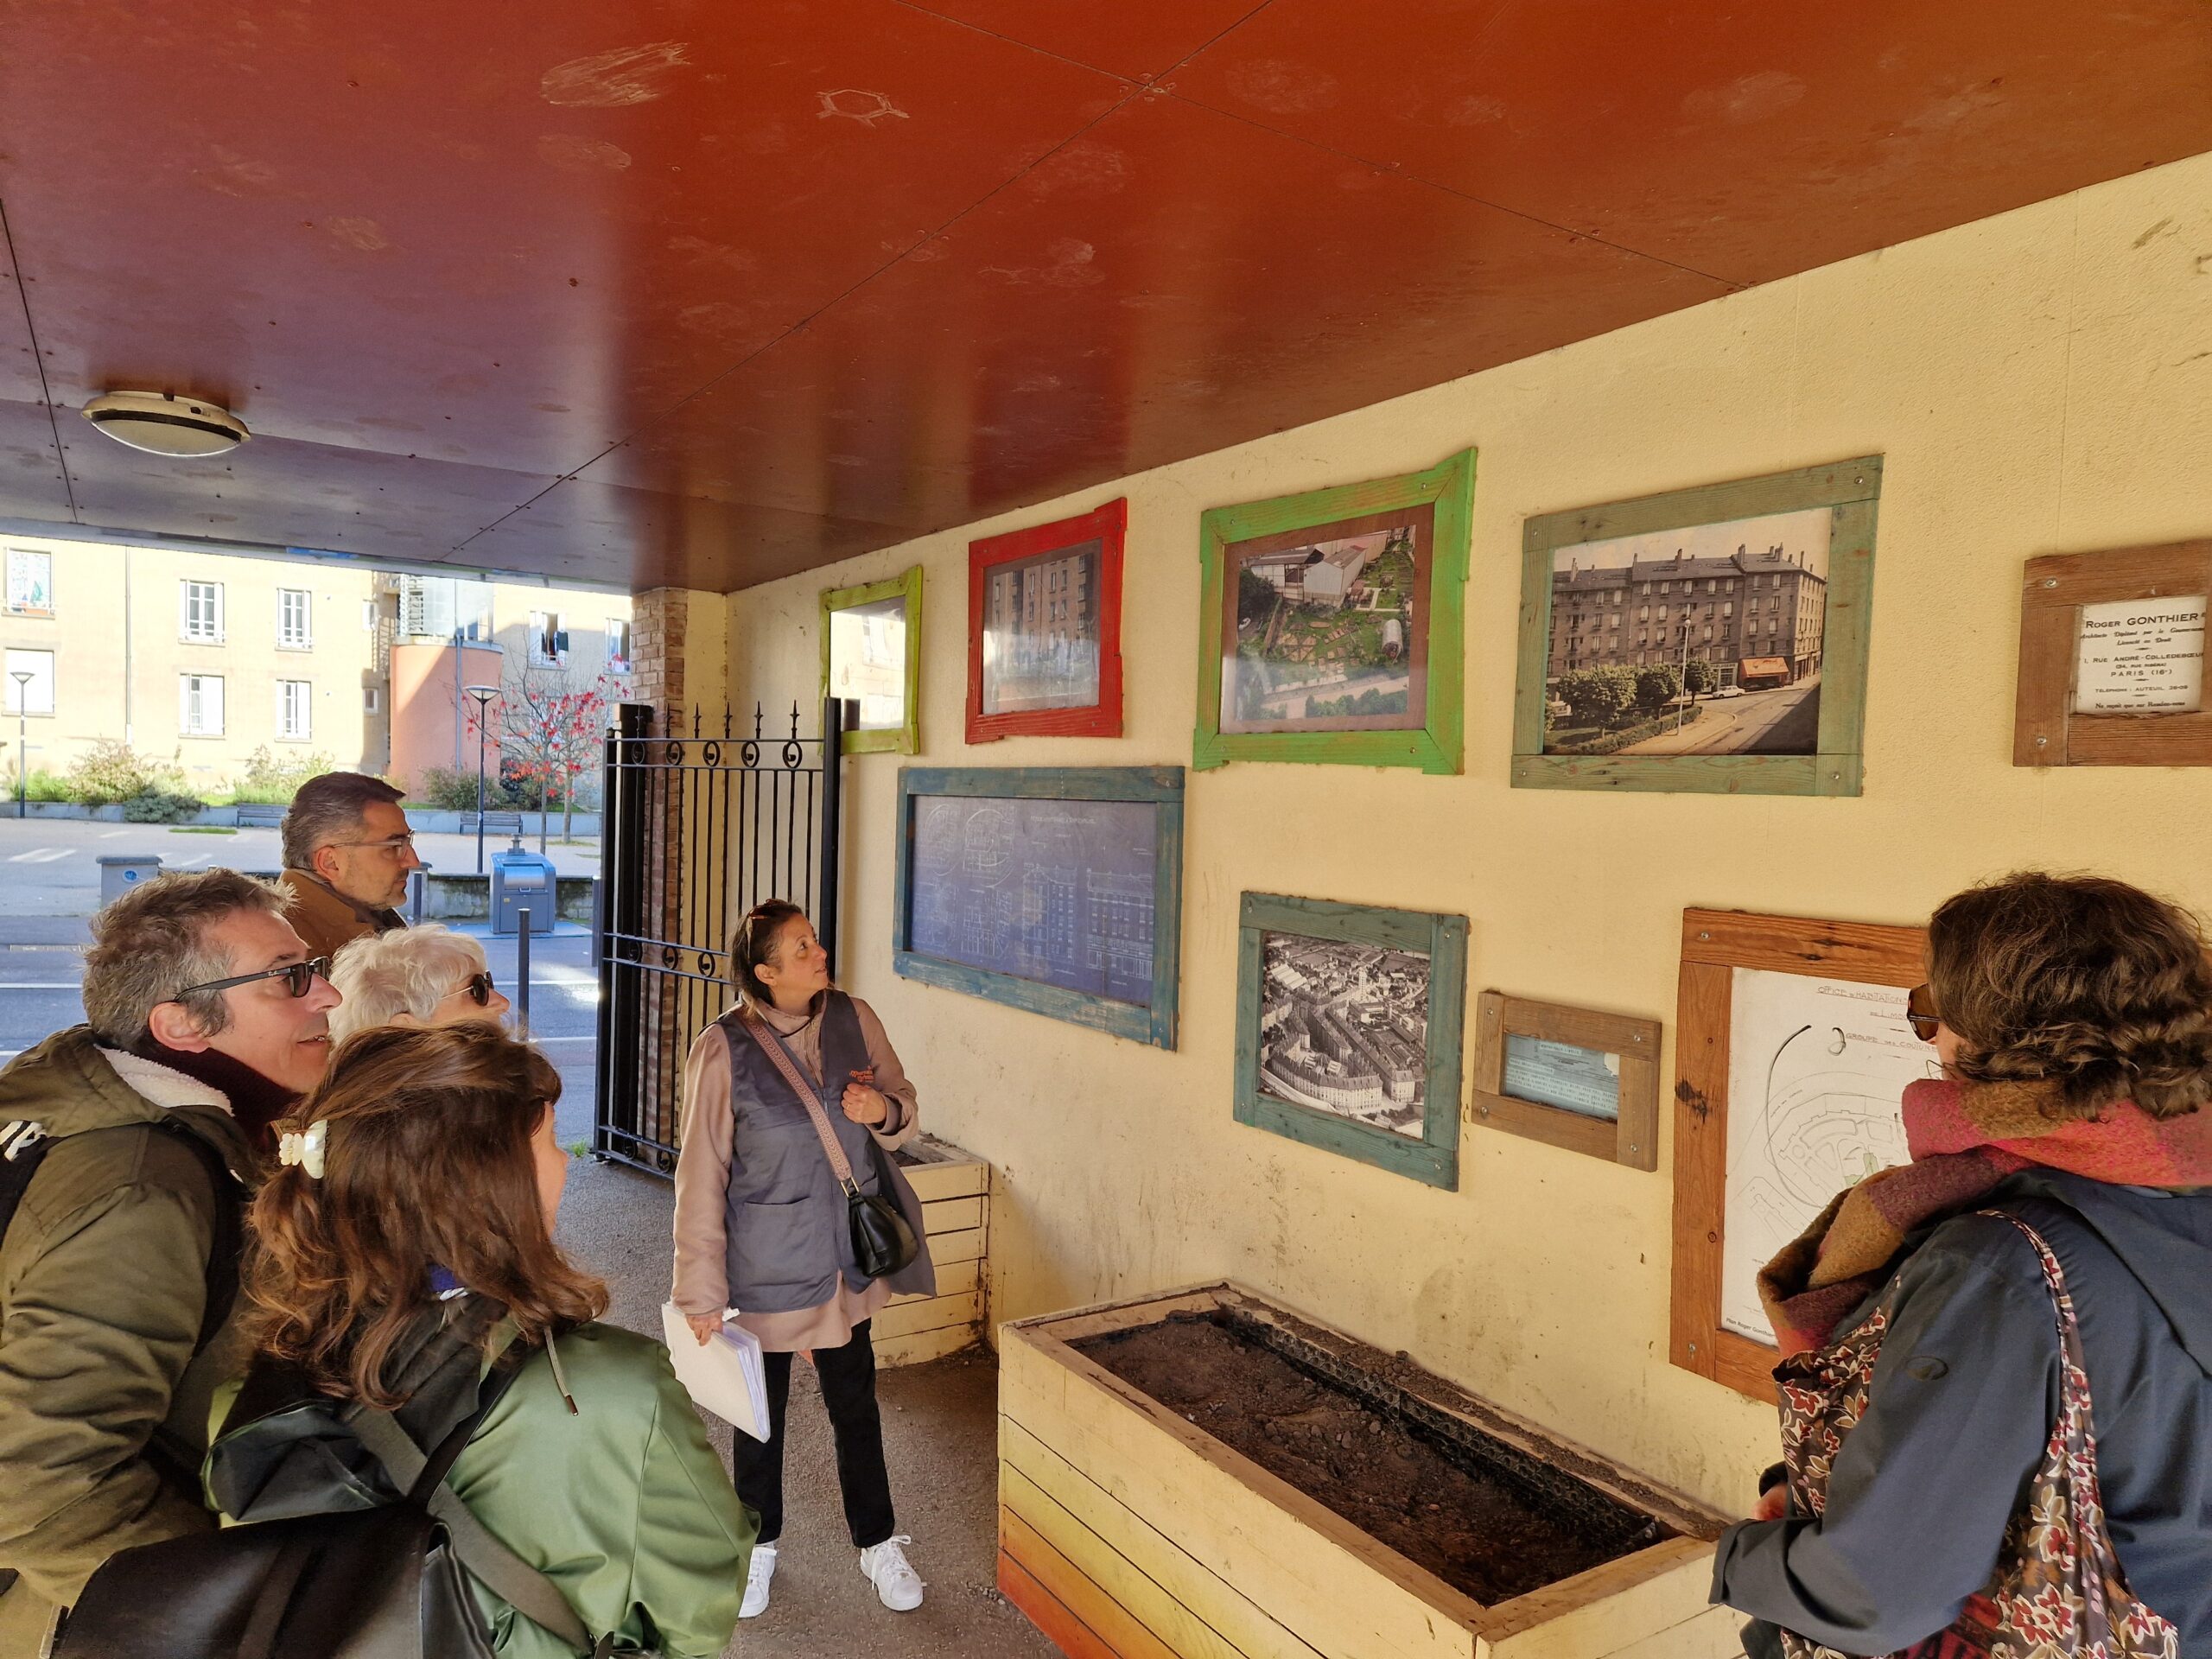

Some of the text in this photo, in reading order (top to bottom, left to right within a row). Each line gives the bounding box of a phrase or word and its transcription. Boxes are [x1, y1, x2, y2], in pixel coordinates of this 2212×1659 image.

[2126, 613, 2198, 626] GONTHIER
[1846, 1033, 1878, 1044] GROUPE
[1738, 1321, 1752, 1332] Roger
